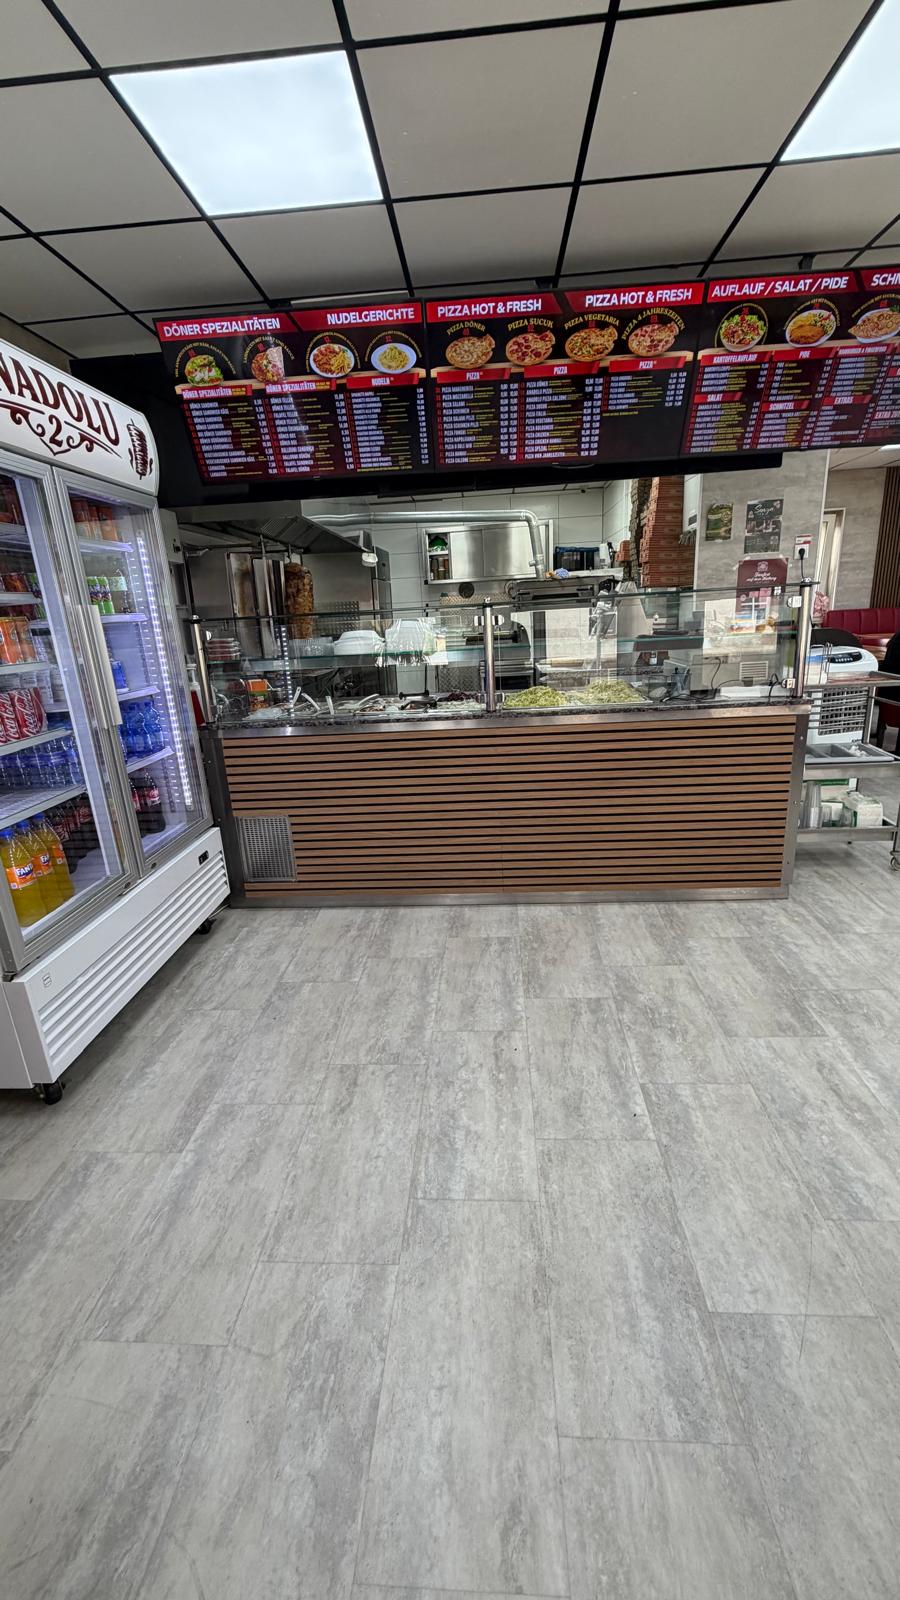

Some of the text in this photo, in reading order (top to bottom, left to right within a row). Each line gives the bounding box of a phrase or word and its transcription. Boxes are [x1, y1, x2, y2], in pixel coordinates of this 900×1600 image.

[712, 283, 765, 297] AUFLAUF
[774, 279, 812, 293] SALAT
[821, 277, 849, 289] PIDE
[585, 288, 692, 308] PIZZA HOT & FRESH
[327, 308, 415, 325] NUDELGERICHTE
[437, 299, 542, 318] PIZZA HOT & FRESH
[163, 317, 281, 337] DÖNER SPEZIALITÄTEN
[446, 322, 464, 336] PIZZA
[464, 320, 486, 333] DÖNER
[507, 317, 554, 331] PIZZA SUCUK
[564, 313, 620, 330] PIZZA VEGETARIA
[621, 319, 638, 340] PIZZA
[641, 307, 686, 331] JAHRESZEITEN
[48, 414, 64, 448] 2
